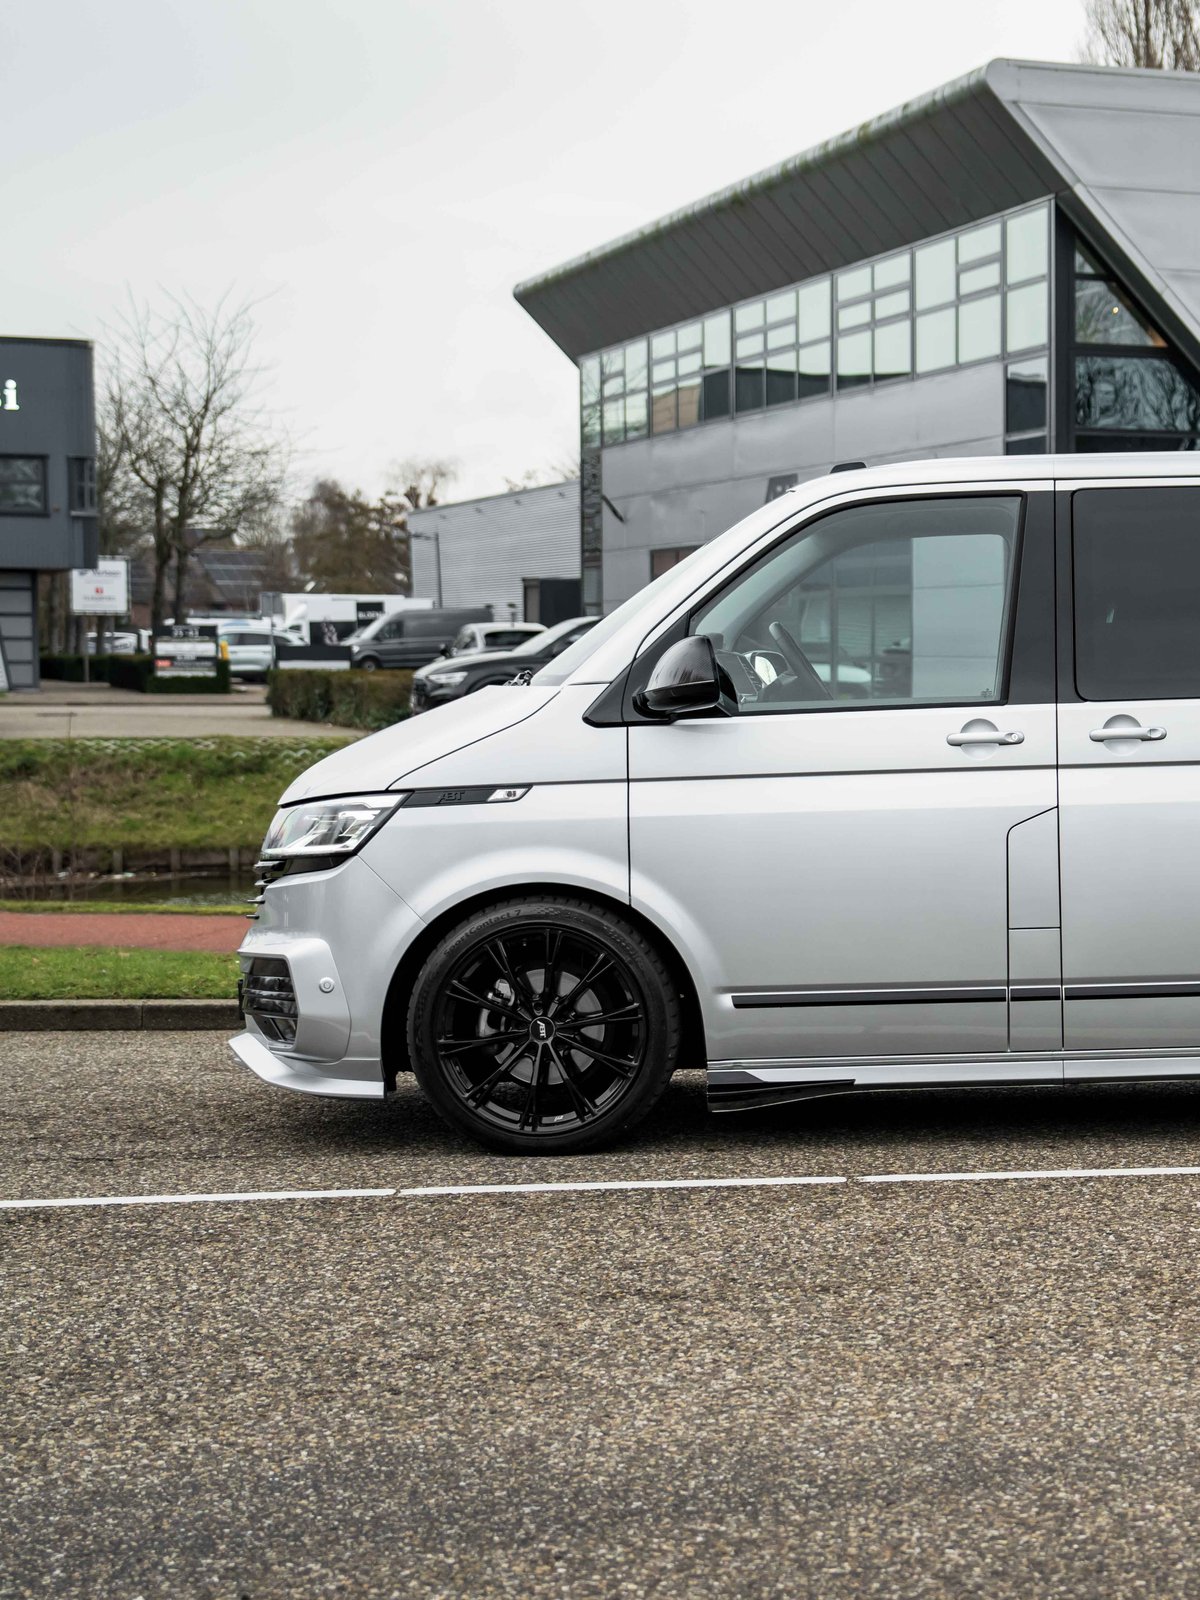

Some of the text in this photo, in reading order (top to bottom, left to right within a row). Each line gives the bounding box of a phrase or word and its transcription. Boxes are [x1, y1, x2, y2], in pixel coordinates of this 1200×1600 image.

[0, 379, 20, 411] i
[434, 790, 466, 804] ABT
[443, 912, 511, 955] SportContact
